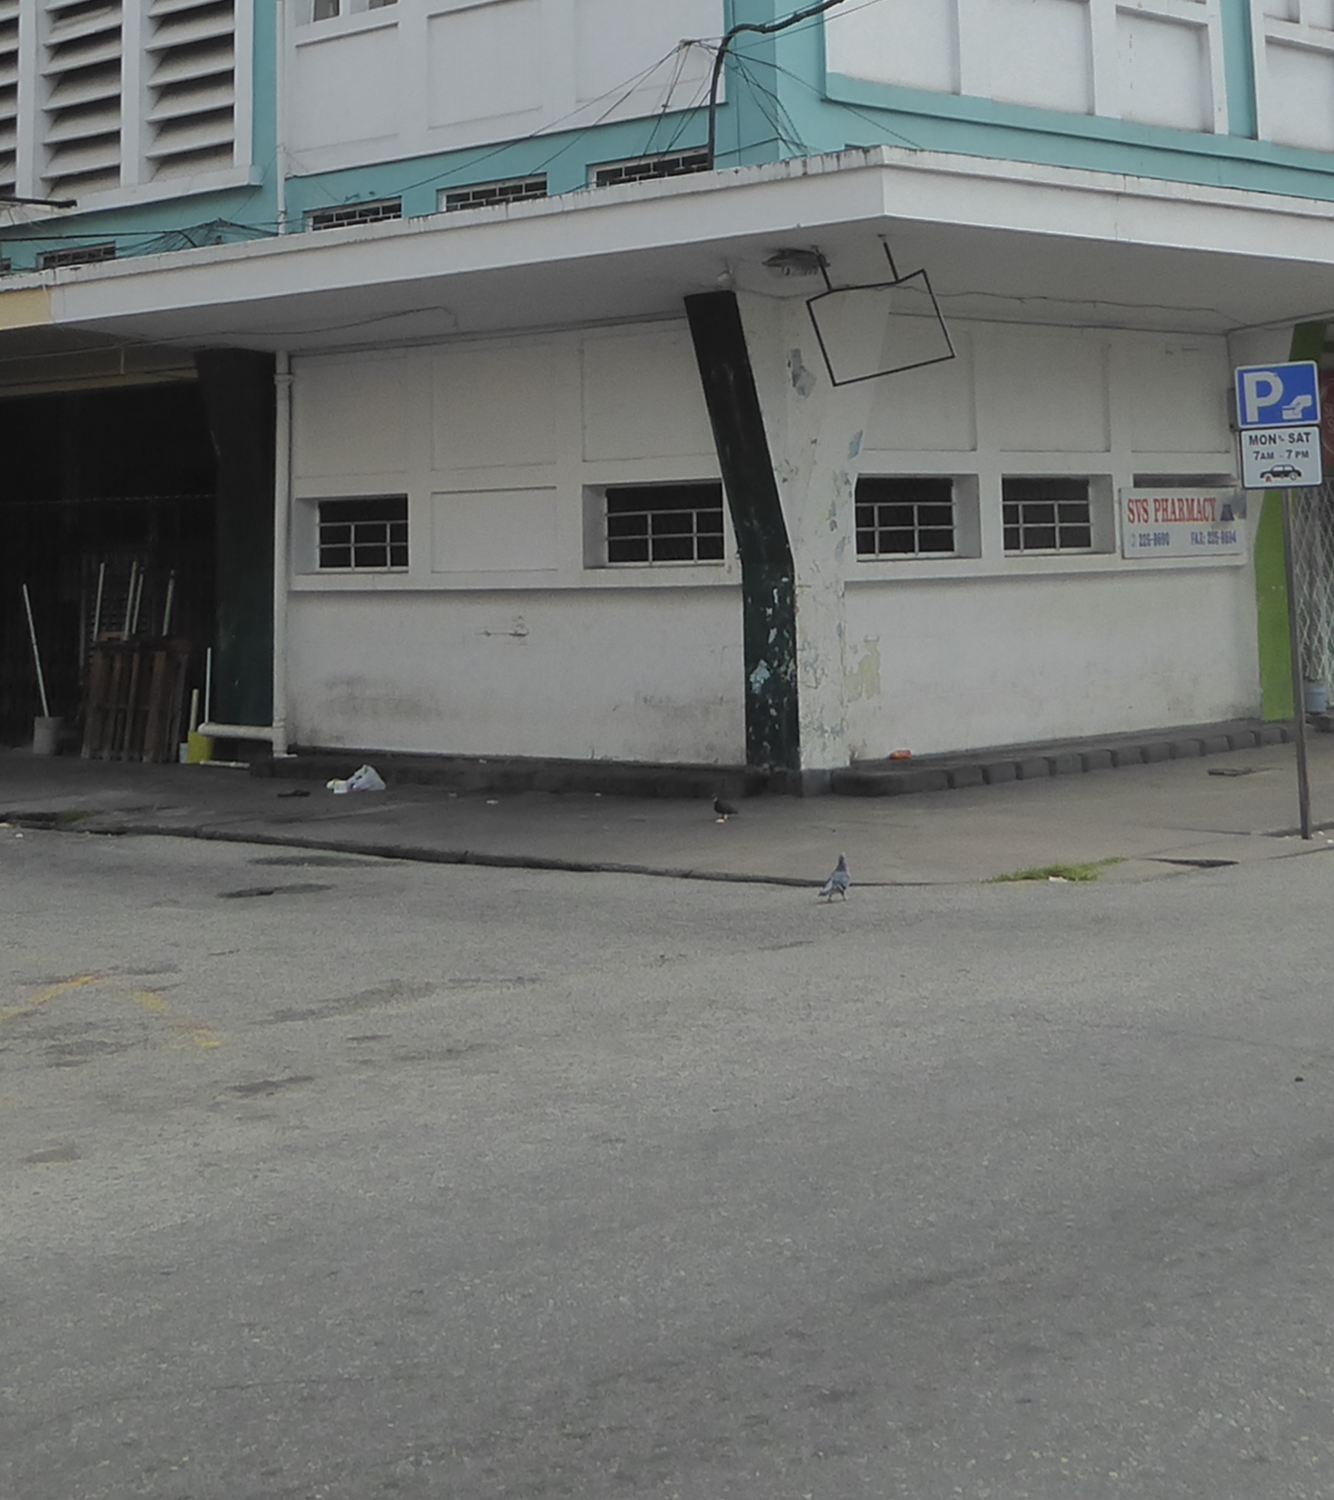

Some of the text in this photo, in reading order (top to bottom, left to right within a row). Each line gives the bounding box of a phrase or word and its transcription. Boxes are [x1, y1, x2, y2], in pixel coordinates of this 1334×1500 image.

[1243, 371, 1284, 423] P
[1248, 433, 1277, 446] MON
[1288, 431, 1312, 444] SAT
[1127, 496, 1216, 525] SVS PHARMACY
